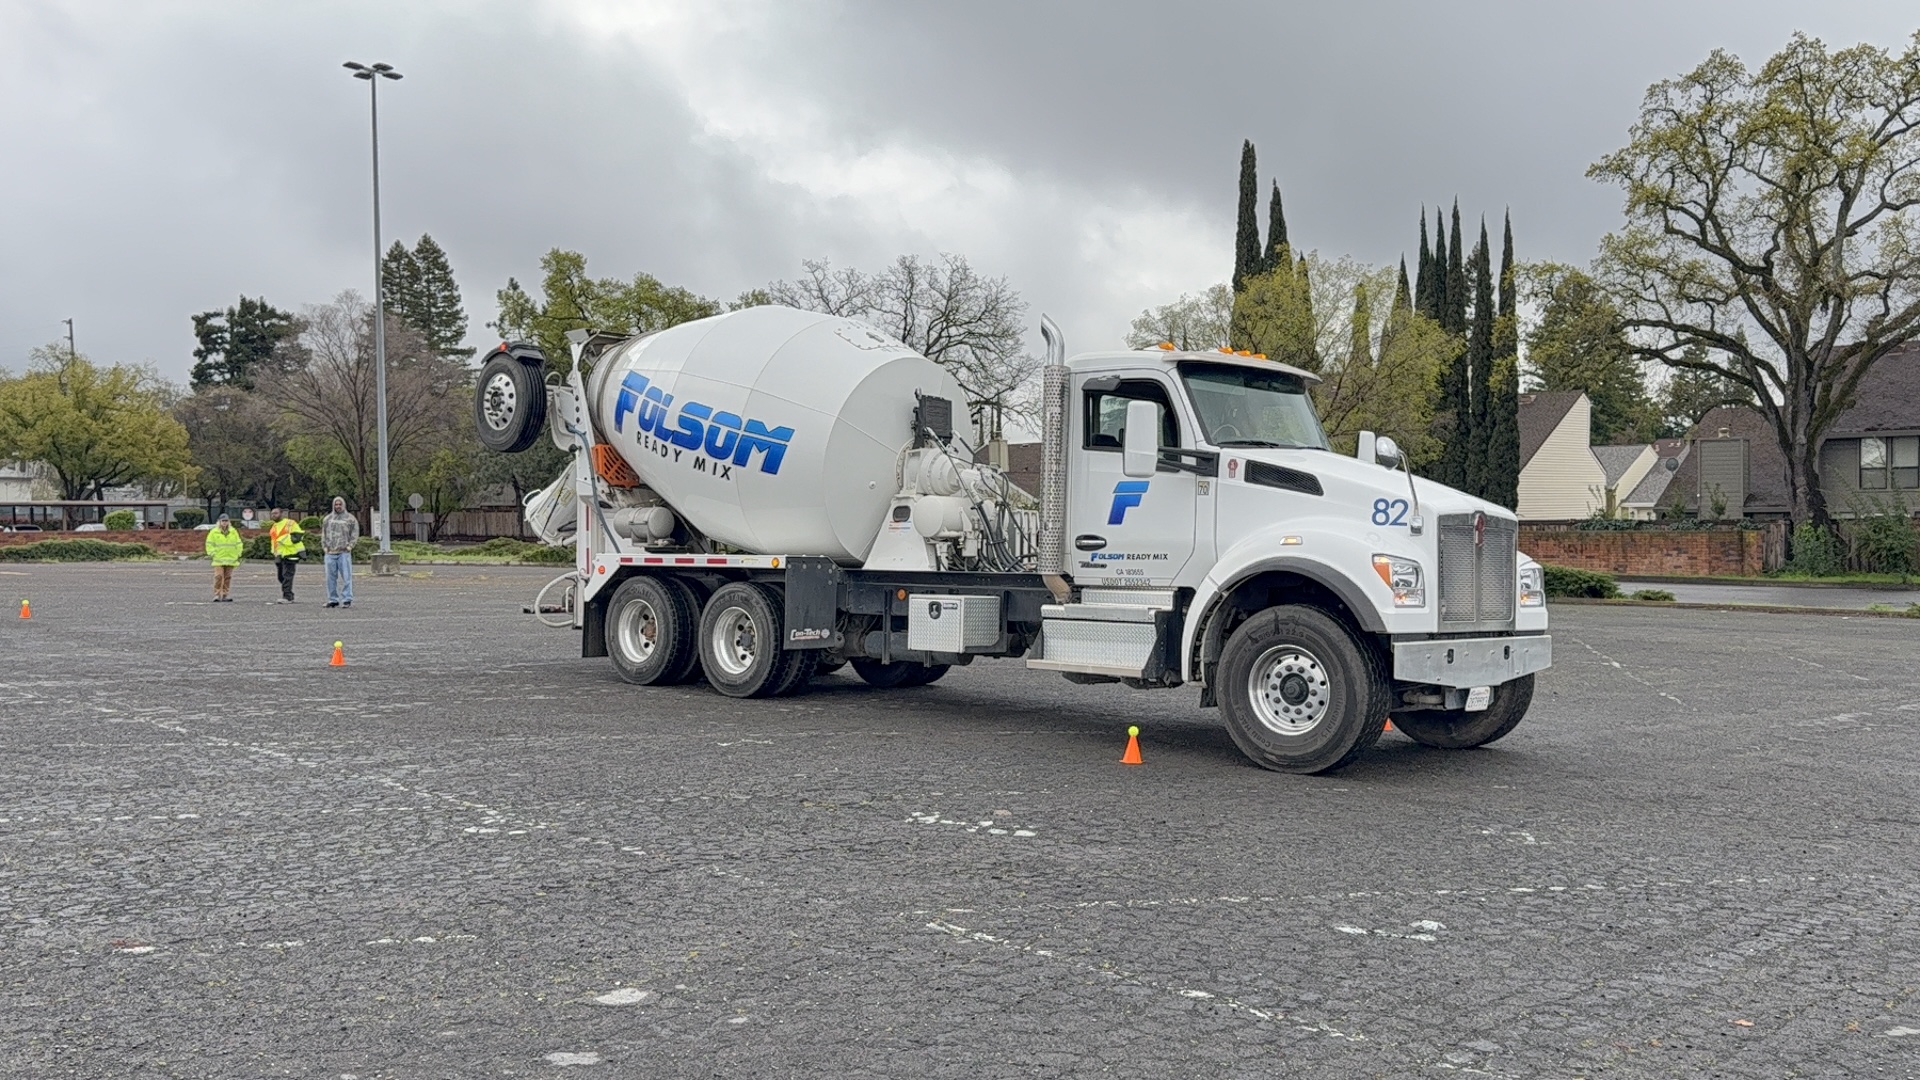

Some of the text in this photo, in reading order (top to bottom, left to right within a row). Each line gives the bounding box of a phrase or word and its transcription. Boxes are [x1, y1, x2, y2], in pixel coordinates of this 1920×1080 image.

[614, 370, 795, 475] FOLSOM
[636, 430, 732, 481] READY MIX
[1107, 481, 1150, 525] F
[1371, 498, 1409, 526] 82
[1091, 552, 1169, 562] FOLSOM READY MIX
[1101, 577, 1122, 586] USDOT
[1115, 568, 1124, 576] CA
